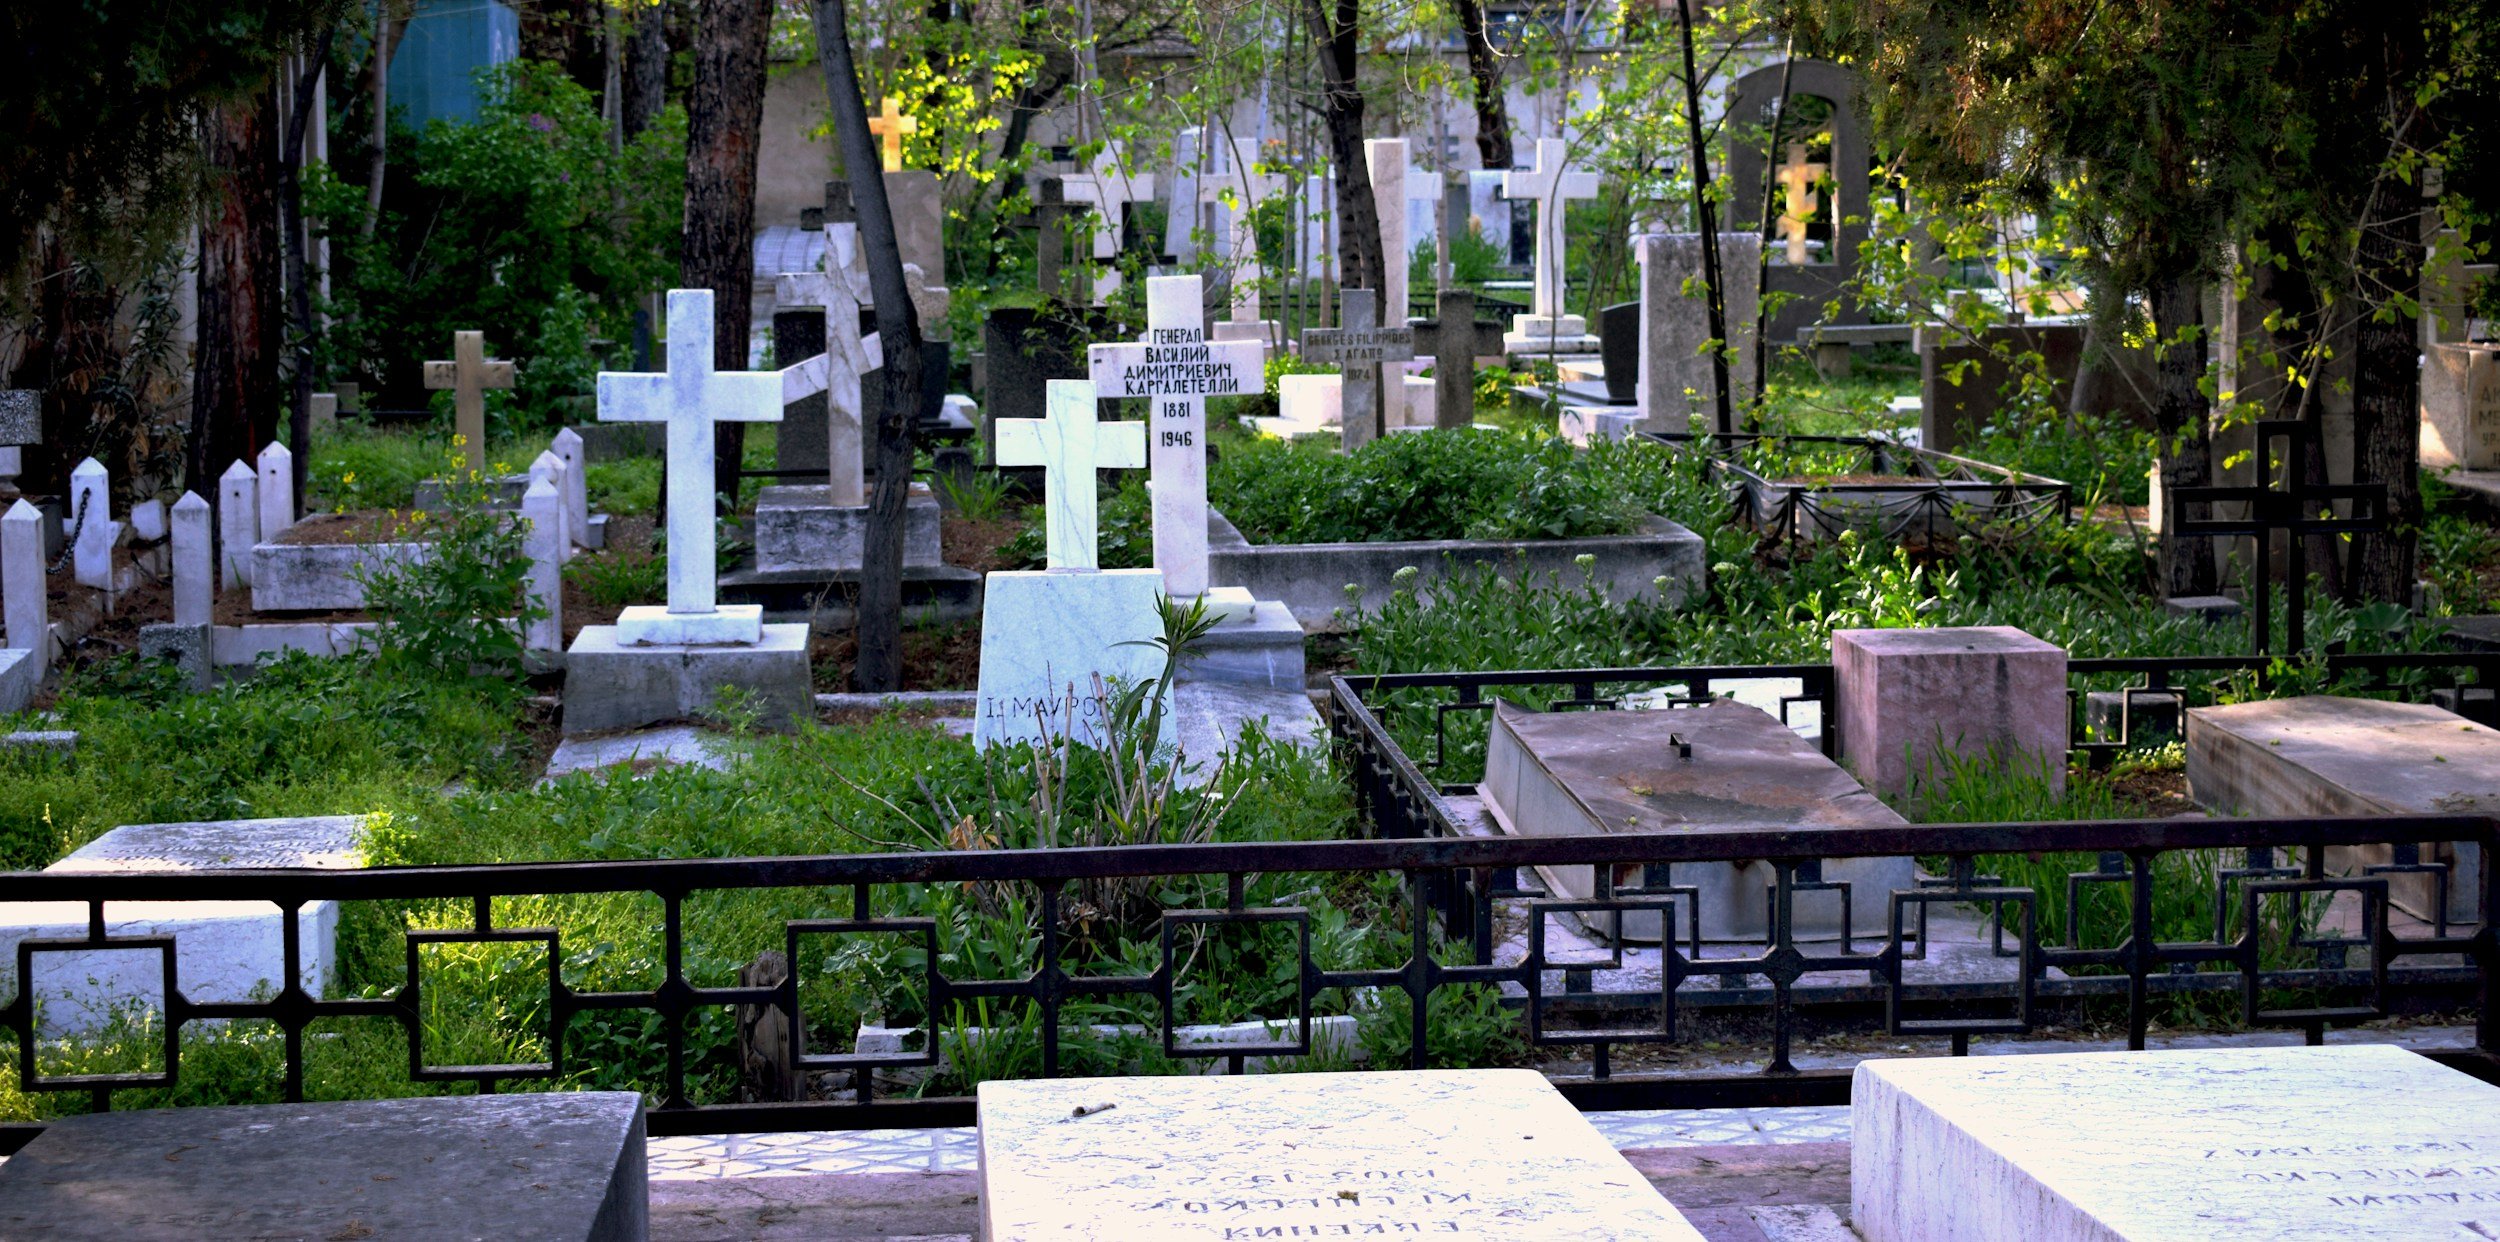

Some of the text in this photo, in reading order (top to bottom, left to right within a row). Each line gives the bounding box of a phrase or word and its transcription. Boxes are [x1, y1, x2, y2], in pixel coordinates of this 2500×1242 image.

[1153, 328, 1201, 344] ГЕНЕРАЛ
[1145, 345, 1209, 363] ВАСИЛИЙ
[1123, 363, 1231, 380] ДИМИТРИЕВИЧ
[1126, 378, 1238, 395] КАРГАЛЕТЕЛЛИ
[1163, 402, 1190, 418] 1881
[1161, 431, 1192, 447] 1946
